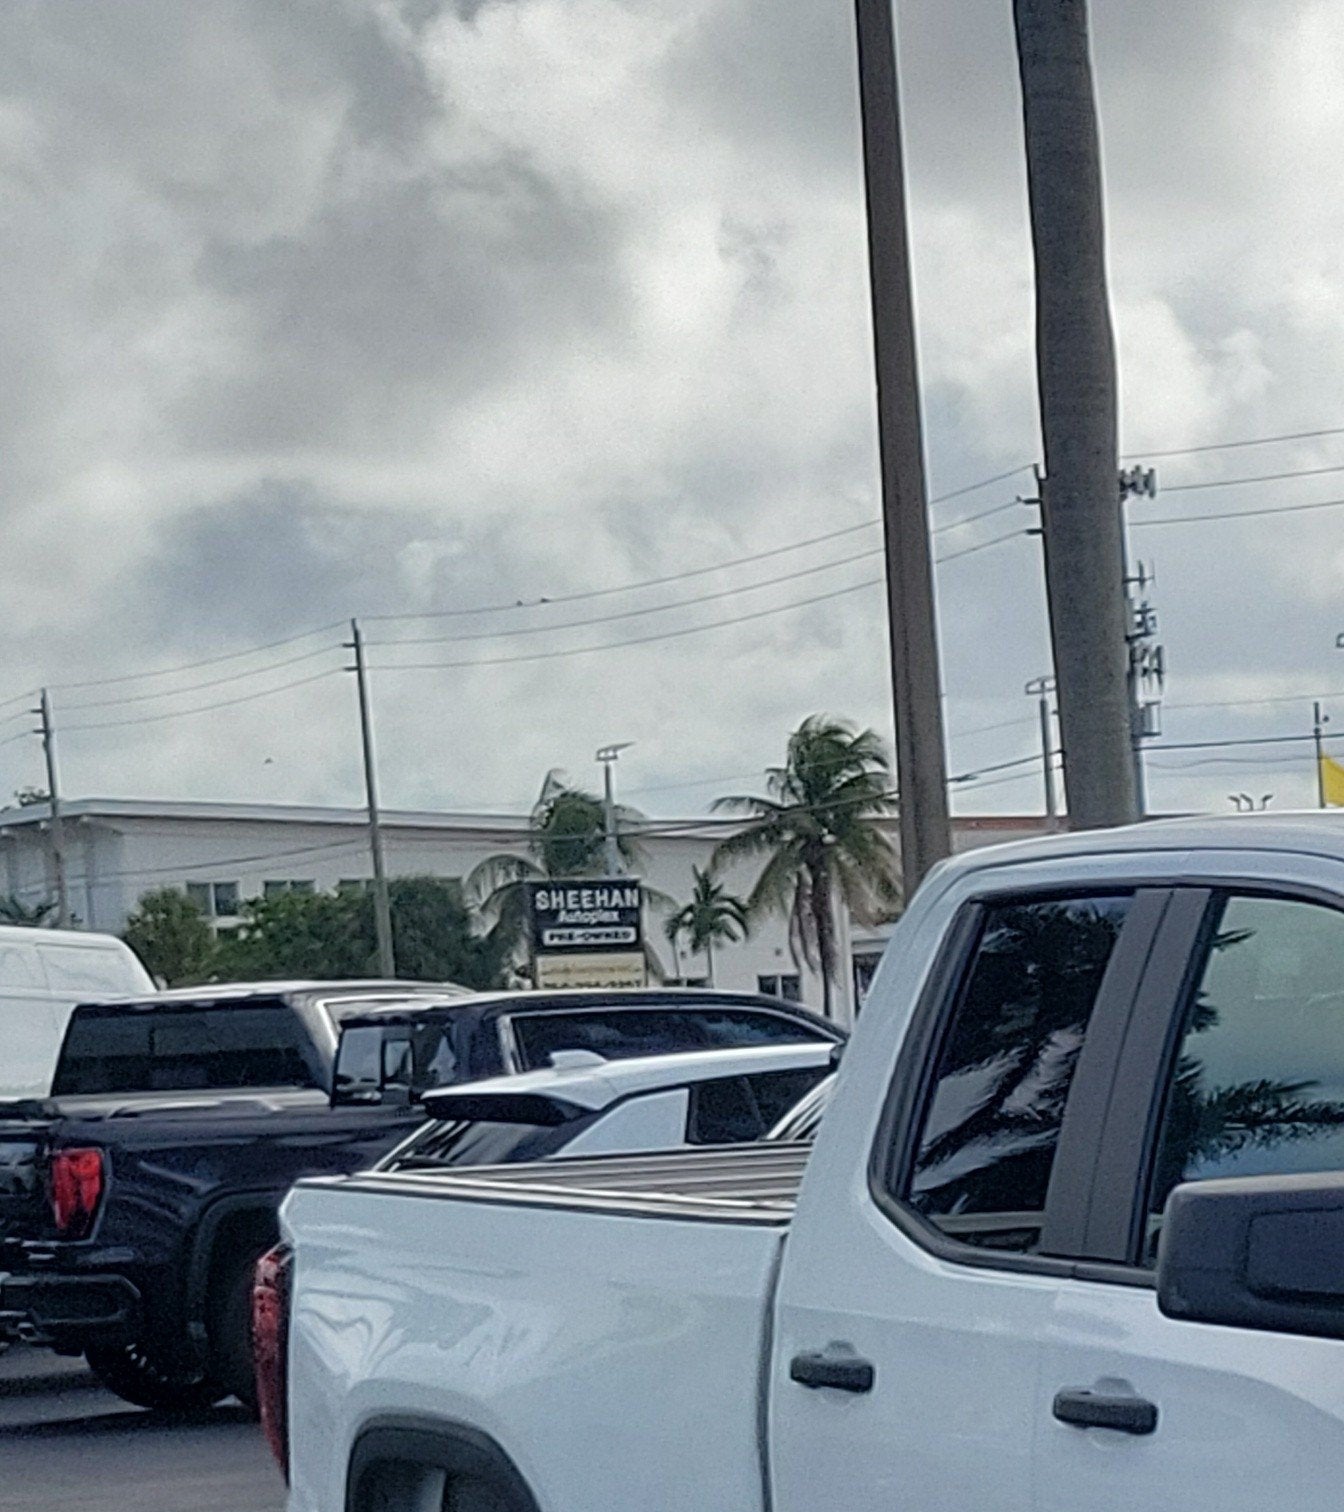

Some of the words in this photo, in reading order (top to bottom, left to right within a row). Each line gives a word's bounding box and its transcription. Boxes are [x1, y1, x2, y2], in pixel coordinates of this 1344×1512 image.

[536, 889, 639, 910] SHEEHAN
[558, 910, 620, 925] Autoplex
[549, 931, 632, 941] PRE-OWNED
